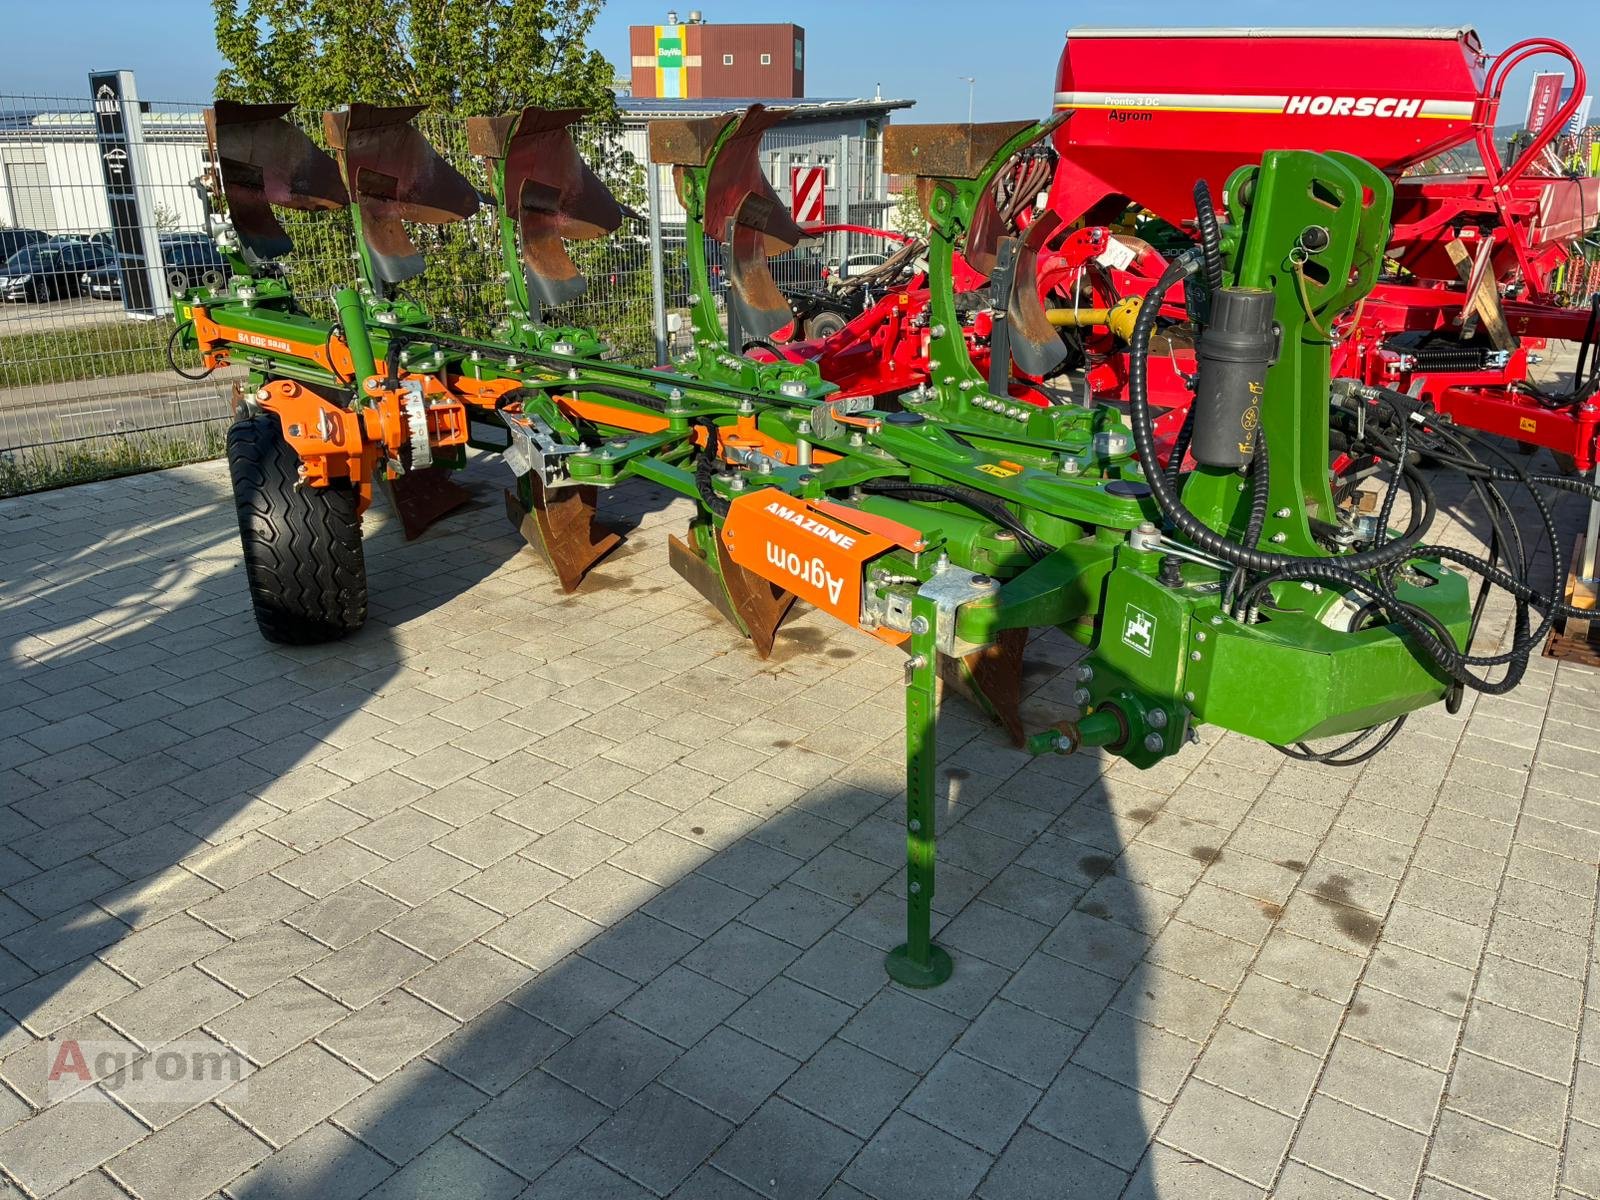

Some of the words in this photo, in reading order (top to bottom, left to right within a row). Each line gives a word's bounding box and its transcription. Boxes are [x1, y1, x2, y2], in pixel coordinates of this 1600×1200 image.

[658, 47, 682, 57] BayWa
[1104, 96, 1135, 106] Pronto
[1136, 97, 1144, 106] 3
[1145, 97, 1160, 106] DC
[1285, 95, 1422, 118] HORSCH
[1109, 109, 1153, 123] Agrom
[250, 335, 267, 347] 300
[764, 502, 857, 550] AMAZONE
[766, 540, 845, 606] Agrom
